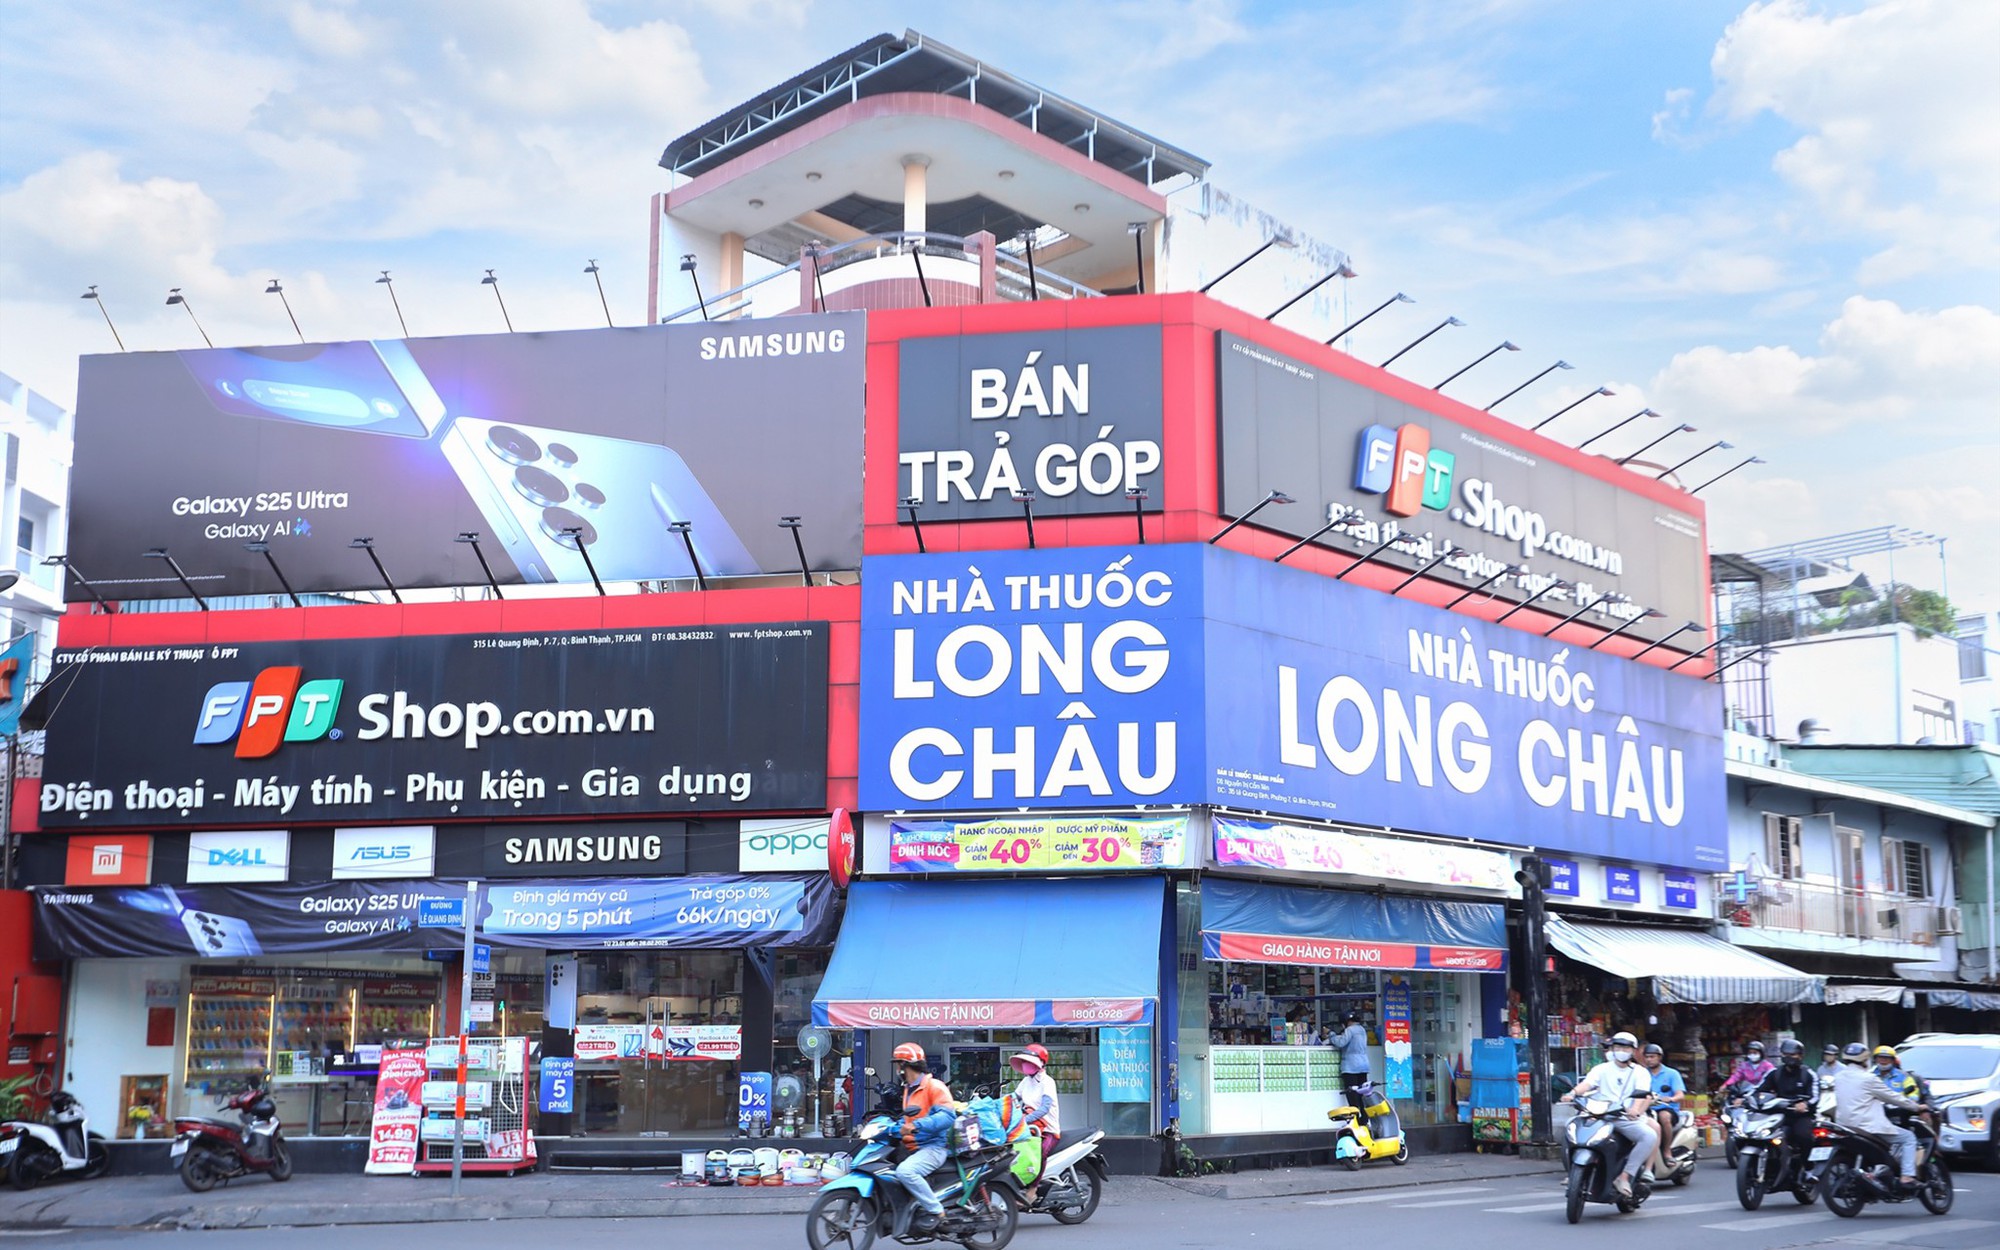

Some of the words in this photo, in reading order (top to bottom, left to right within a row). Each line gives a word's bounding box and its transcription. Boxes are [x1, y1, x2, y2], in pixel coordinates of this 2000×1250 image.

[700, 329, 846, 360] SAMSUNG
[971, 351, 1089, 420] BÁN
[899, 431, 1024, 503] TRẢ
[1035, 425, 1161, 497] GÓP
[172, 496, 252, 518] Galaxy
[255, 492, 292, 512] S25
[297, 491, 348, 510] Ultra
[204, 522, 271, 541] Galaxy
[274, 520, 291, 537] AI
[892, 565, 996, 615] NHÀ
[1004, 553, 1173, 611] THUỐC
[473, 639, 486, 648] 315
[487, 637, 496, 648] Lê
[498, 638, 521, 649] Quang
[522, 637, 542, 649] Định,
[571, 635, 588, 645] Bình
[615, 633, 642, 644] TP.HCM
[56, 652, 74, 664] CTY
[120, 648, 143, 662] BÁN
[221, 648, 239, 658] FPT
[893, 619, 1170, 698] LONG
[1408, 626, 1483, 689] NHÀ
[1488, 647, 1596, 713] THUỐC
[358, 691, 655, 749] Shop.com.vn
[889, 701, 1177, 801] CHÂU
[1278, 664, 1492, 794] LONG
[1518, 715, 1685, 827] CHÂU
[40, 781, 113, 820] Điện
[124, 779, 205, 817] thoại
[233, 775, 301, 815] Máy
[311, 774, 373, 806] tính
[406, 774, 464, 814] Phụ
[480, 770, 546, 808] kiện
[581, 767, 640, 797] Gia
[659, 766, 752, 801] dụng
[987, 825, 1016, 837] NGOẠI
[1056, 825, 1083, 834] DƯỢC
[1084, 823, 1099, 833] MỸ
[208, 847, 266, 866] DELL
[350, 846, 411, 861] ASUS
[505, 835, 661, 864] SAMSUNG
[989, 838, 1042, 864] 40%
[1081, 837, 1131, 863] 30%
[43, 894, 94, 904] SAMSUNG
[300, 896, 366, 915] Galaxy
[368, 894, 399, 911] S25
[512, 888, 547, 906] Định
[548, 887, 567, 907] giá
[569, 887, 605, 907] máy
[606, 887, 628, 902] cũ
[689, 886, 718, 900] Trả
[719, 887, 747, 903] góp
[748, 886, 770, 899] 0%
[325, 919, 378, 936] Galaxy
[380, 917, 395, 932] AI
[503, 909, 563, 931] Trong
[566, 909, 579, 926] 5
[582, 907, 632, 930] phút
[676, 907, 780, 931] 66k/ngày
[1262, 943, 1294, 957] GIAO
[1296, 941, 1332, 959] HÀNG
[1334, 944, 1358, 962] TẬN
[1360, 947, 1381, 962] NƠI
[475, 973, 492, 981] 315
[868, 1006, 902, 1021] GIAO
[903, 1002, 939, 1020] HÀNG
[941, 1002, 968, 1023] TẬN
[970, 1003, 994, 1019] NƠI
[1072, 1009, 1096, 1019] 1800
[1097, 1009, 1123, 1019] 6928
[1114, 1046, 1137, 1060] ĐIỂM
[545, 1069, 563, 1078] máy
[1101, 1060, 1119, 1073] BÁN
[1120, 1060, 1150, 1073] THUỐC
[552, 1079, 566, 1098] 5
[1108, 1075, 1129, 1088] BÌNH
[548, 1099, 569, 1110] phút
[739, 1084, 766, 1106] 0%
